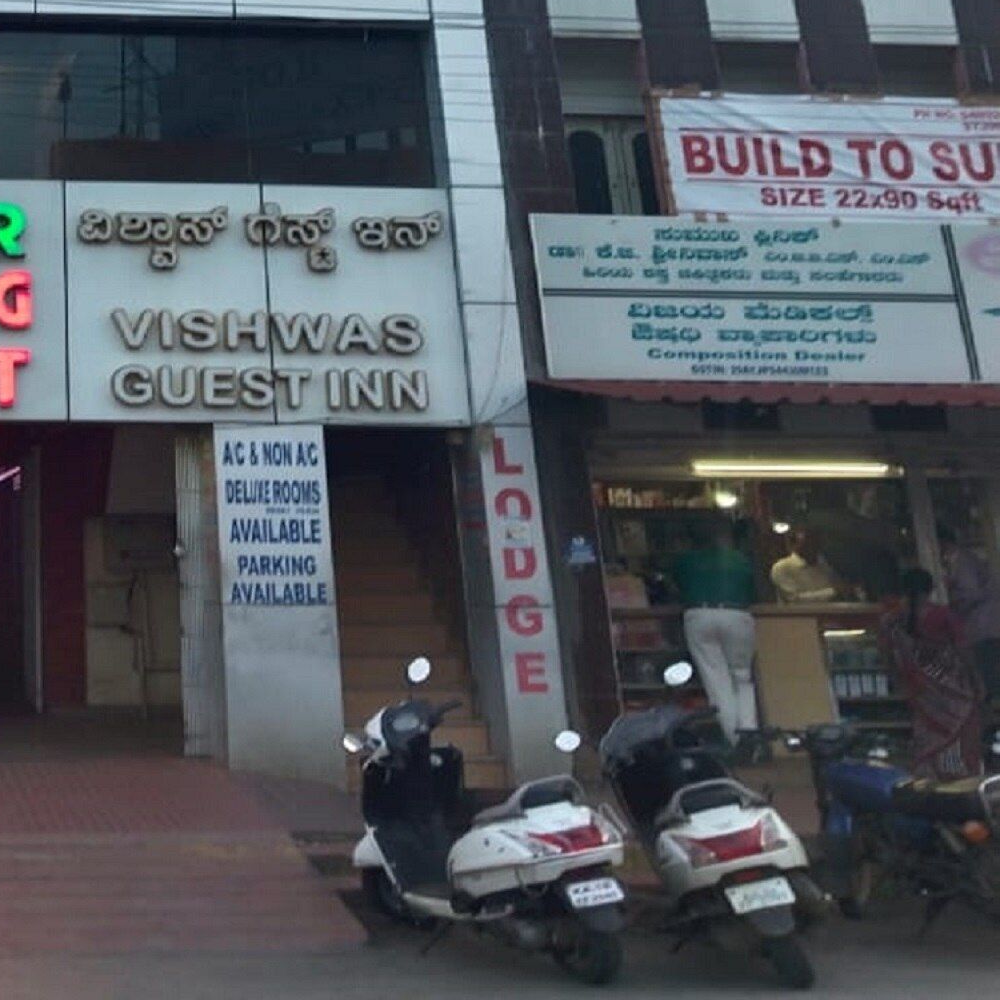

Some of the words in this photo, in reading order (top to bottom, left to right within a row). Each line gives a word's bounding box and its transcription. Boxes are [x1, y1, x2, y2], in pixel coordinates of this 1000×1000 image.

[680, 135, 832, 179] BUILD
[847, 140, 914, 181] TO
[929, 140, 1000, 182] SU
[760, 187, 826, 208] SIZE
[836, 188, 918, 210] 22x90
[926, 190, 984, 214] Sqft
[77, 204, 229, 271] ವಿಶ್ವಾಸ್
[351, 210, 444, 251] ಇನ್
[111, 308, 424, 355] VISHWAS
[647, 350, 787, 362] Composition
[111, 363, 311, 411] GUEST
[326, 368, 430, 412] INN
[250, 442, 258, 466] &
[262, 442, 292, 466] NON
[225, 480, 270, 504] DELUXE
[273, 480, 321, 505] ROOMS
[230, 519, 322, 544] AVAILABLE
[237, 555, 317, 576] PARKING
[493, 434, 549, 693] LODGE
[231, 583, 328, 605] AVAILABLE
